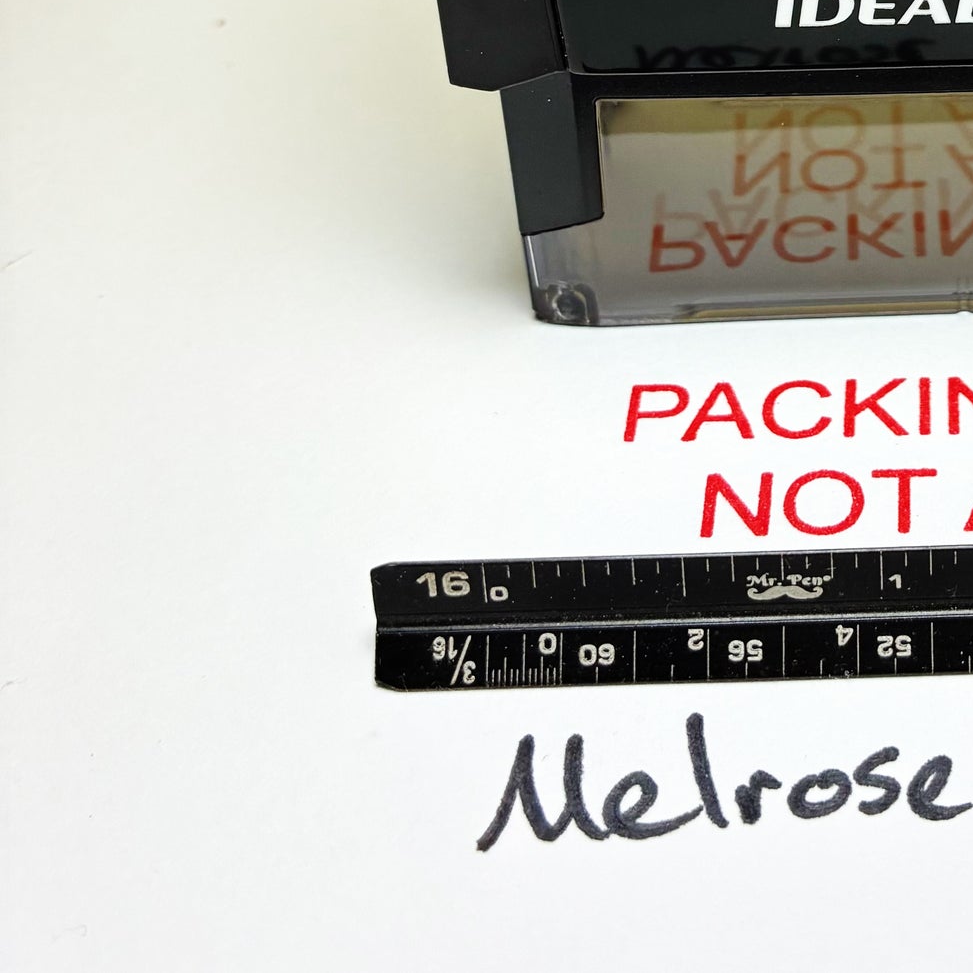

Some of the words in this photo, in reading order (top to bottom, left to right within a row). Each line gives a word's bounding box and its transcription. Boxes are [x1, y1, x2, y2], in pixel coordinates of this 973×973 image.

[700, 467, 938, 538] NOT
[416, 570, 471, 597] 16
[746, 572, 783, 587] Mr.
[888, 573, 902, 589] 1
[539, 632, 557, 655] 0
[688, 628, 705, 651] 2
[836, 624, 854, 647] 4
[877, 634, 912, 658] 52
[579, 643, 616, 667] 60
[728, 639, 763, 662] 56
[477, 712, 973, 852] Melrose
